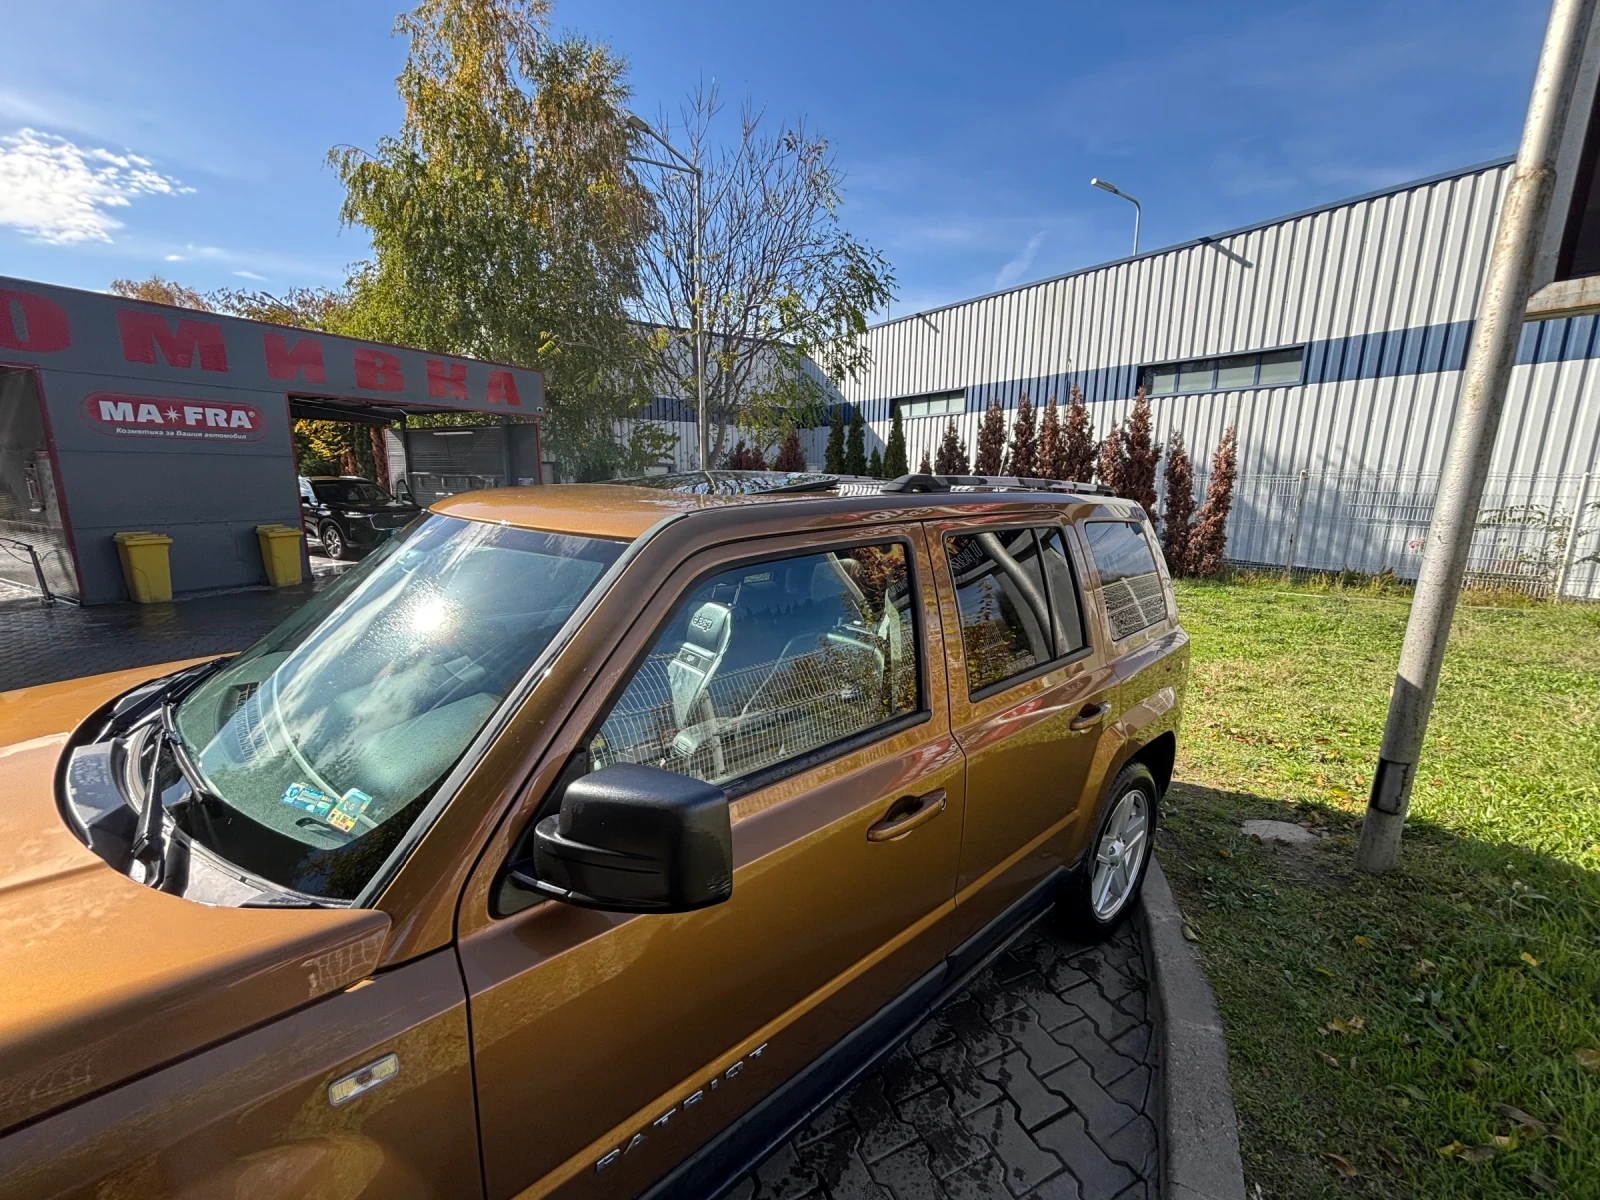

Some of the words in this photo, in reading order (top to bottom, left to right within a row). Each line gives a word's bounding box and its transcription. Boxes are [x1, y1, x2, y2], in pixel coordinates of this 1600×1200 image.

[116, 427, 163, 436] Козметика
[176, 430, 202, 438] Вашия
[204, 432, 247, 440] автомобил
[595, 1043, 768, 1173] PATRIOT
